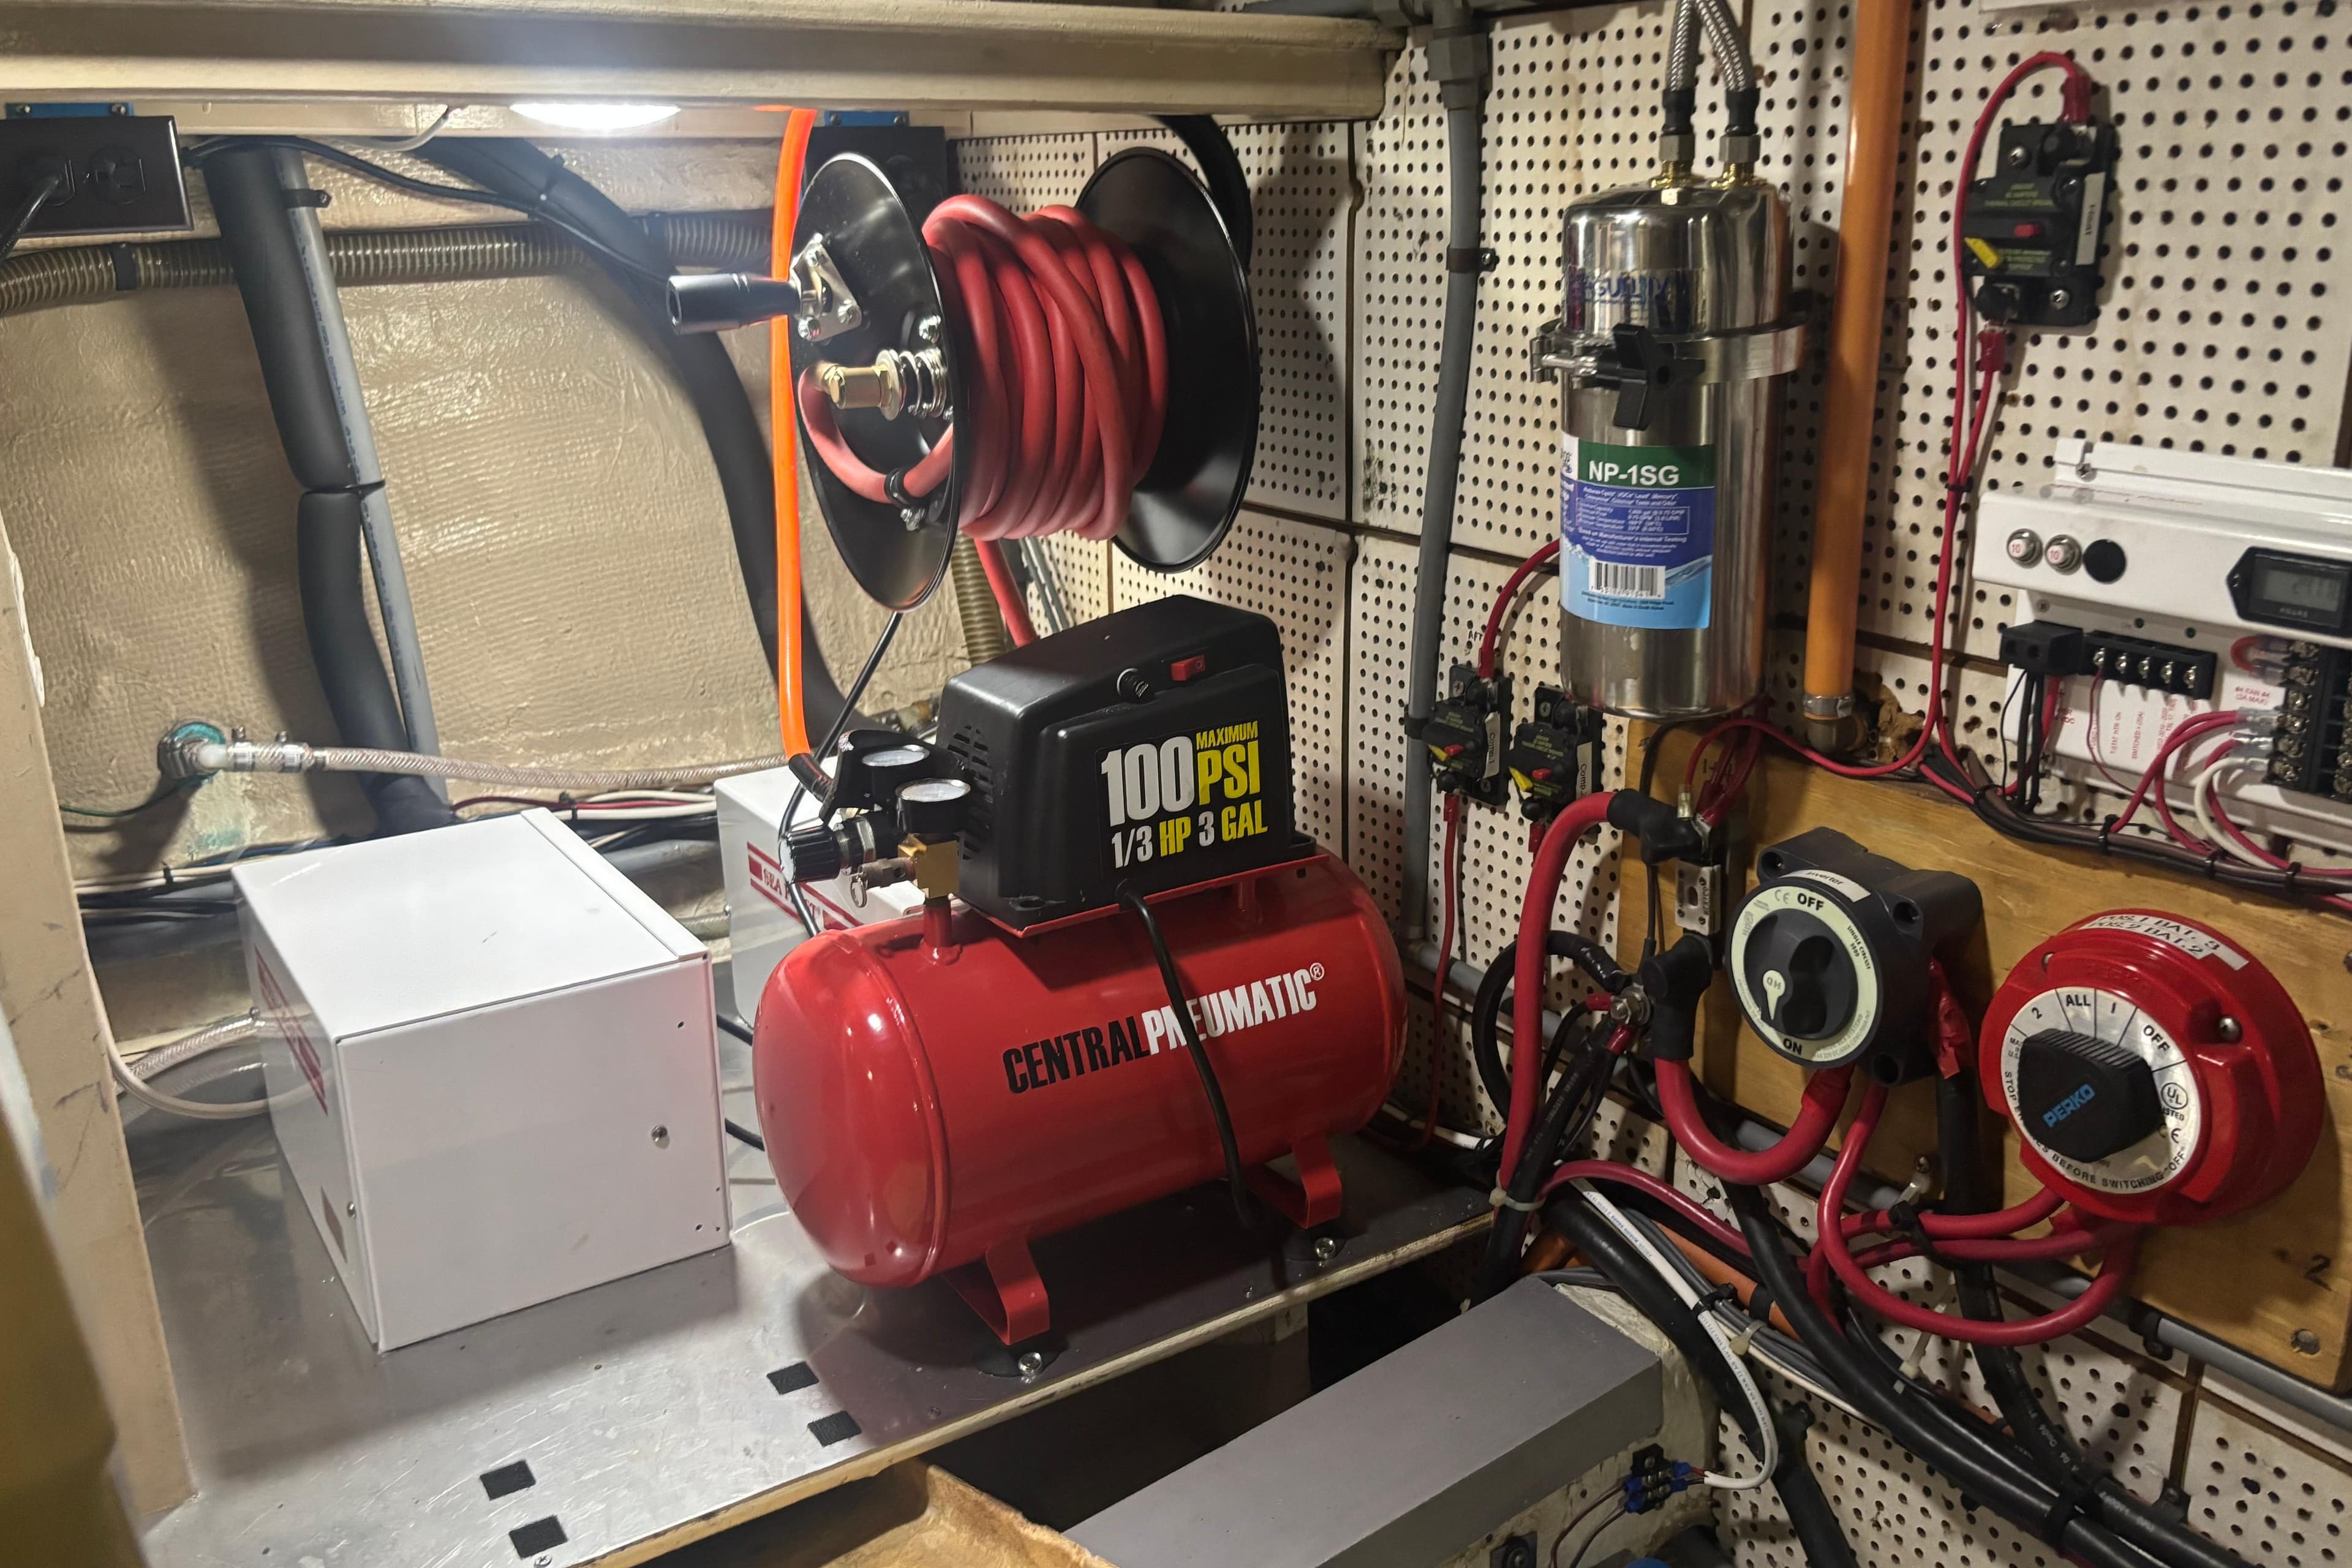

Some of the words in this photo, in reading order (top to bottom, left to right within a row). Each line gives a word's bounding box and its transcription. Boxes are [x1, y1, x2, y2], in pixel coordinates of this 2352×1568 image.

[1588, 460, 1680, 486] NP-1SG
[1196, 720, 1259, 750] MAXIMUM
[1111, 824, 1153, 869] 1/3
[1159, 816, 1191, 858] HP
[1199, 810, 1216, 847] 3
[1221, 798, 1268, 842] GAL
[763, 868, 782, 896] SEA
[1797, 892, 1825, 911] OFF
[2031, 1006, 2043, 1020] 2
[2065, 993, 2092, 1007] ALL
[2143, 1024, 2171, 1052] OFF
[1782, 1038, 1803, 1055] ON
[2043, 1083, 2095, 1128] PERKO
[2005, 1071, 2017, 1101] STOP
[2052, 1153, 2097, 1185] BEFORE
[2101, 1170, 2165, 1190] SWITCHING
[2304, 1253, 2335, 1292] 2
